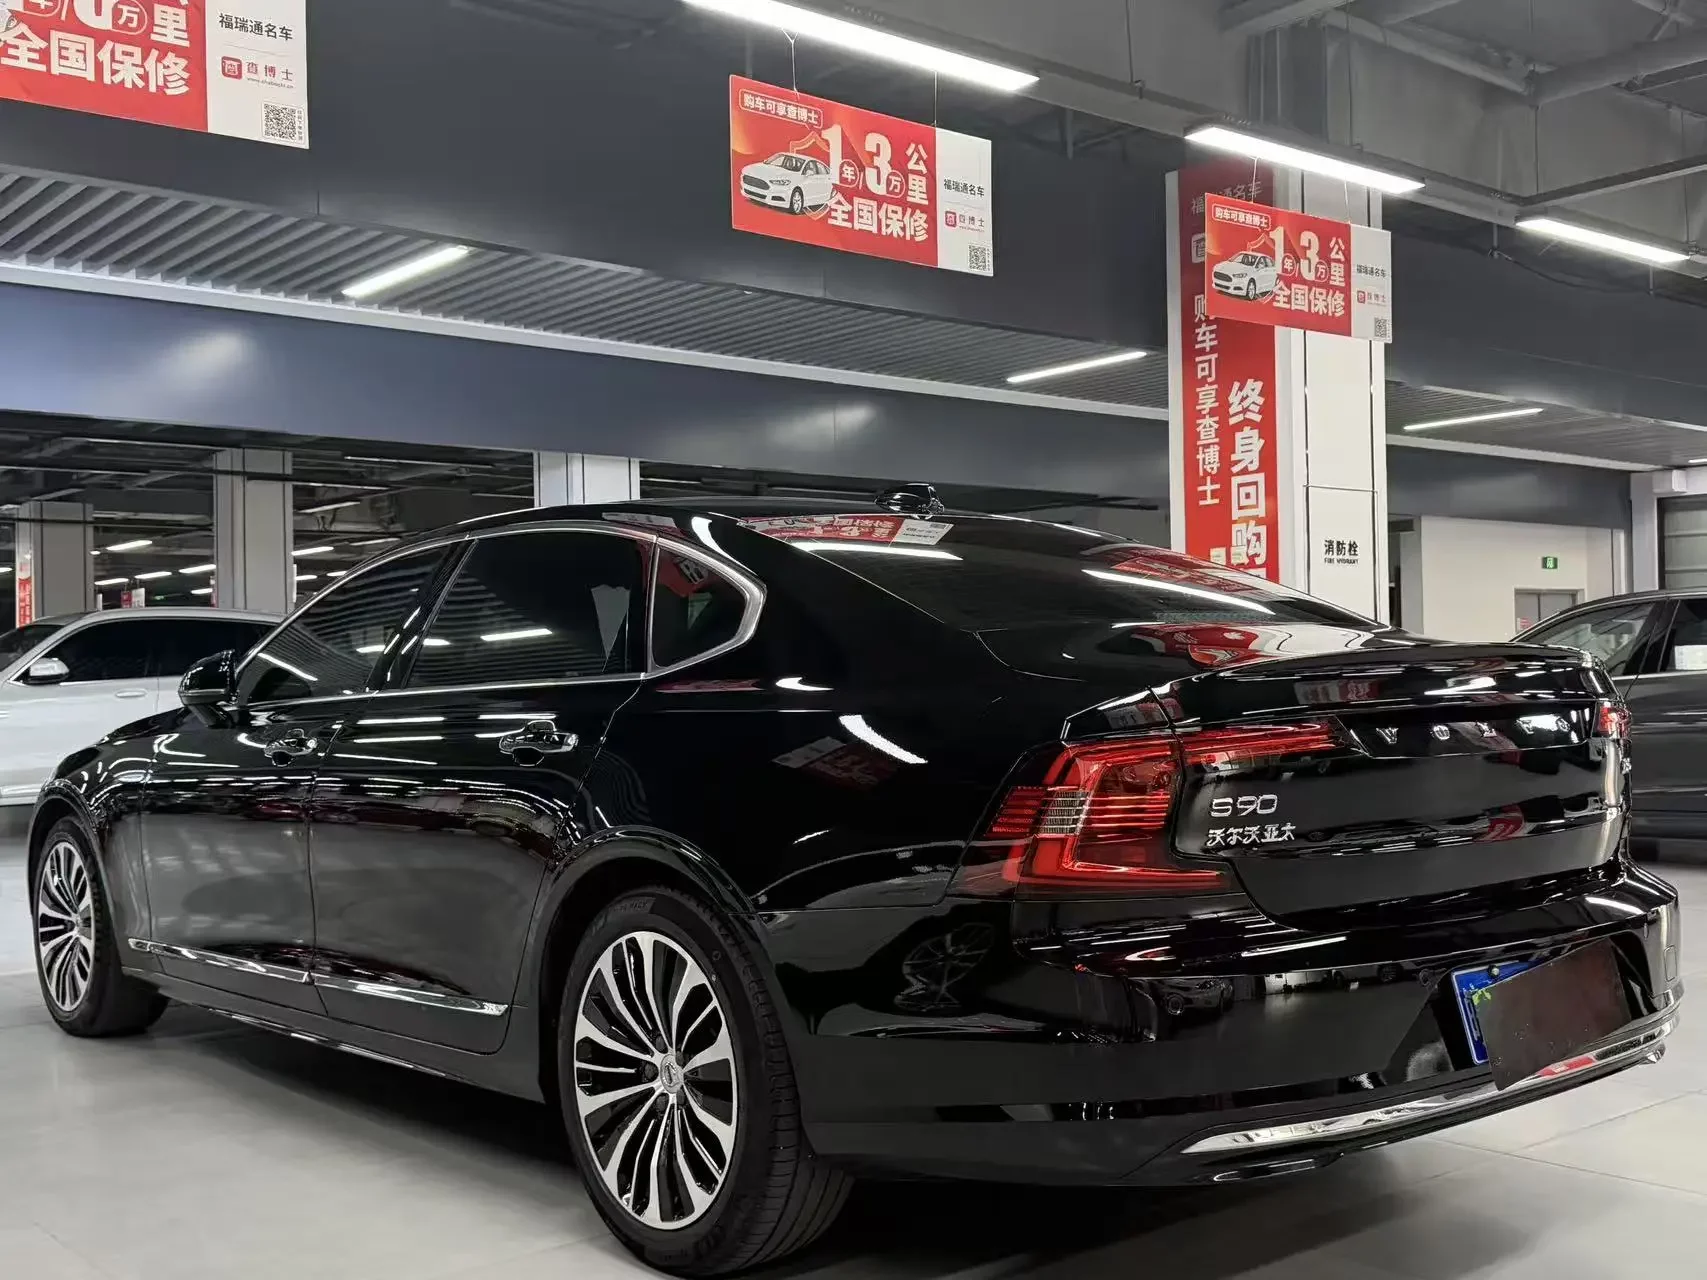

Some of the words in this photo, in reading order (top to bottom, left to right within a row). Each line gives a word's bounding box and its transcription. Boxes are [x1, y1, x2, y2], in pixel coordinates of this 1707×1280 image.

[150, 0, 191, 48] 里
[219, 13, 293, 41] 福瑞通名车
[0, 22, 191, 96] 全国保修
[743, 93, 819, 124] 购车可享查博士
[943, 178, 985, 198] 福瑞通名车
[826, 190, 929, 243] 全国保修
[1214, 205, 1269, 228] 购车可享查博士
[1272, 280, 1346, 318] 全国保修
[1228, 378, 1267, 578] 终身回购
[1324, 540, 1359, 556] 消防栓
[1206, 822, 1297, 847] 沃尔沃亚太
